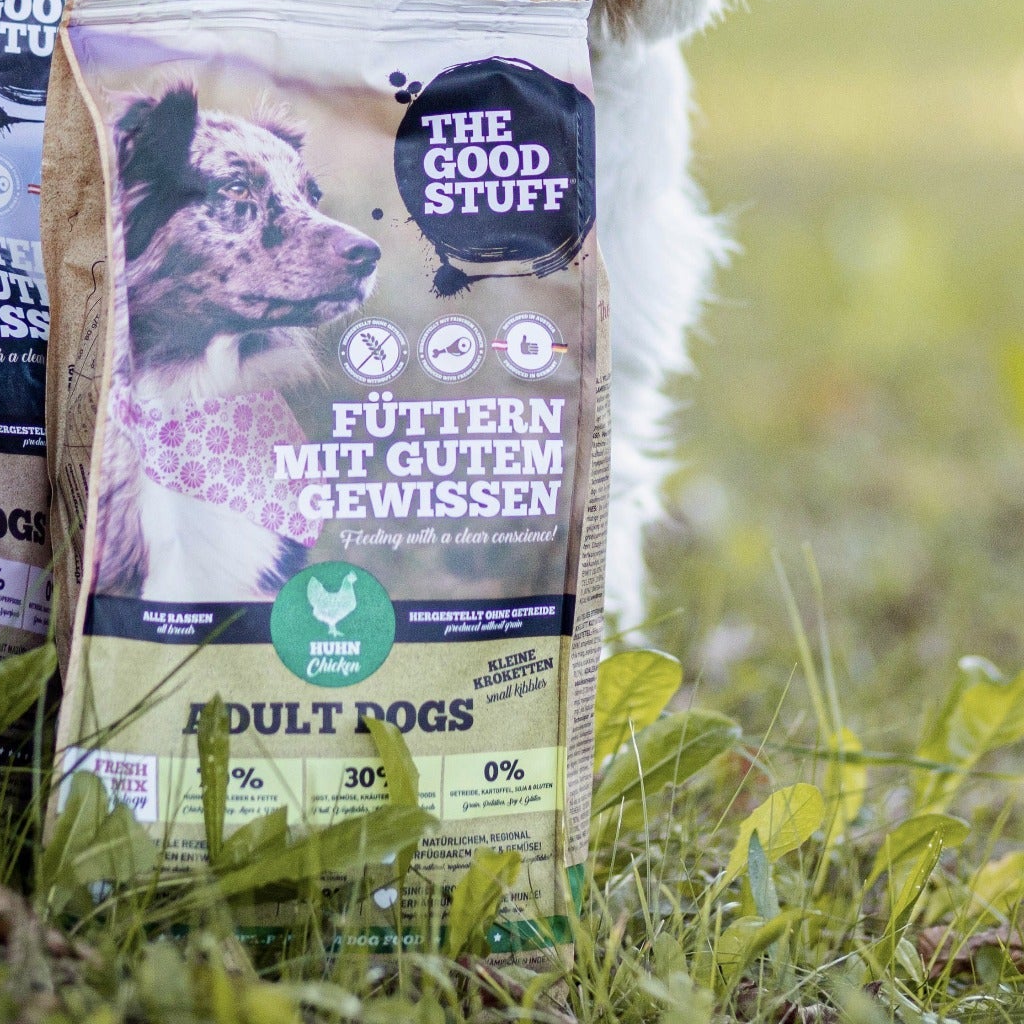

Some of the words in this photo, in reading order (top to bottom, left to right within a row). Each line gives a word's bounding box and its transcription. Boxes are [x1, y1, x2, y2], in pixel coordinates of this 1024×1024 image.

[421, 110, 513, 145] THE
[423, 144, 550, 180] GOOD
[424, 177, 569, 214] STUFF
[9, 352, 19, 363] a
[332, 391, 565, 438] FÜTTERN
[273, 443, 374, 479] MIT
[386, 439, 563, 477] GUTEM
[298, 480, 561, 519] GEWISSEN
[340, 528, 402, 549] Feeding
[404, 528, 436, 546] with
[442, 533, 451, 544] a
[454, 528, 490, 544] clear
[491, 525, 558, 544] conscience!
[142, 611, 166, 622] ALLE
[167, 613, 213, 624] RASSEN
[409, 609, 484, 624] HERGESTELLT
[485, 608, 511, 621] OHNE
[511, 606, 556, 619] GETREIDE
[156, 625, 167, 635] all
[444, 621, 481, 635] produced
[481, 621, 505, 632] without
[505, 621, 523, 634] grain
[309, 641, 361, 656] HUHN
[488, 648, 536, 673] KLEINE
[306, 658, 361, 678] Chicken
[473, 657, 554, 690] KROKETTEN
[486, 685, 514, 704] small
[513, 677, 547, 698] kibbles
[93, 758, 148, 777] FRESH
[483, 759, 525, 783] 0%
[110, 778, 148, 793] MIX
[422, 834, 489, 847] NATÜRLICHEM,
[490, 830, 531, 843] REGIONAL
